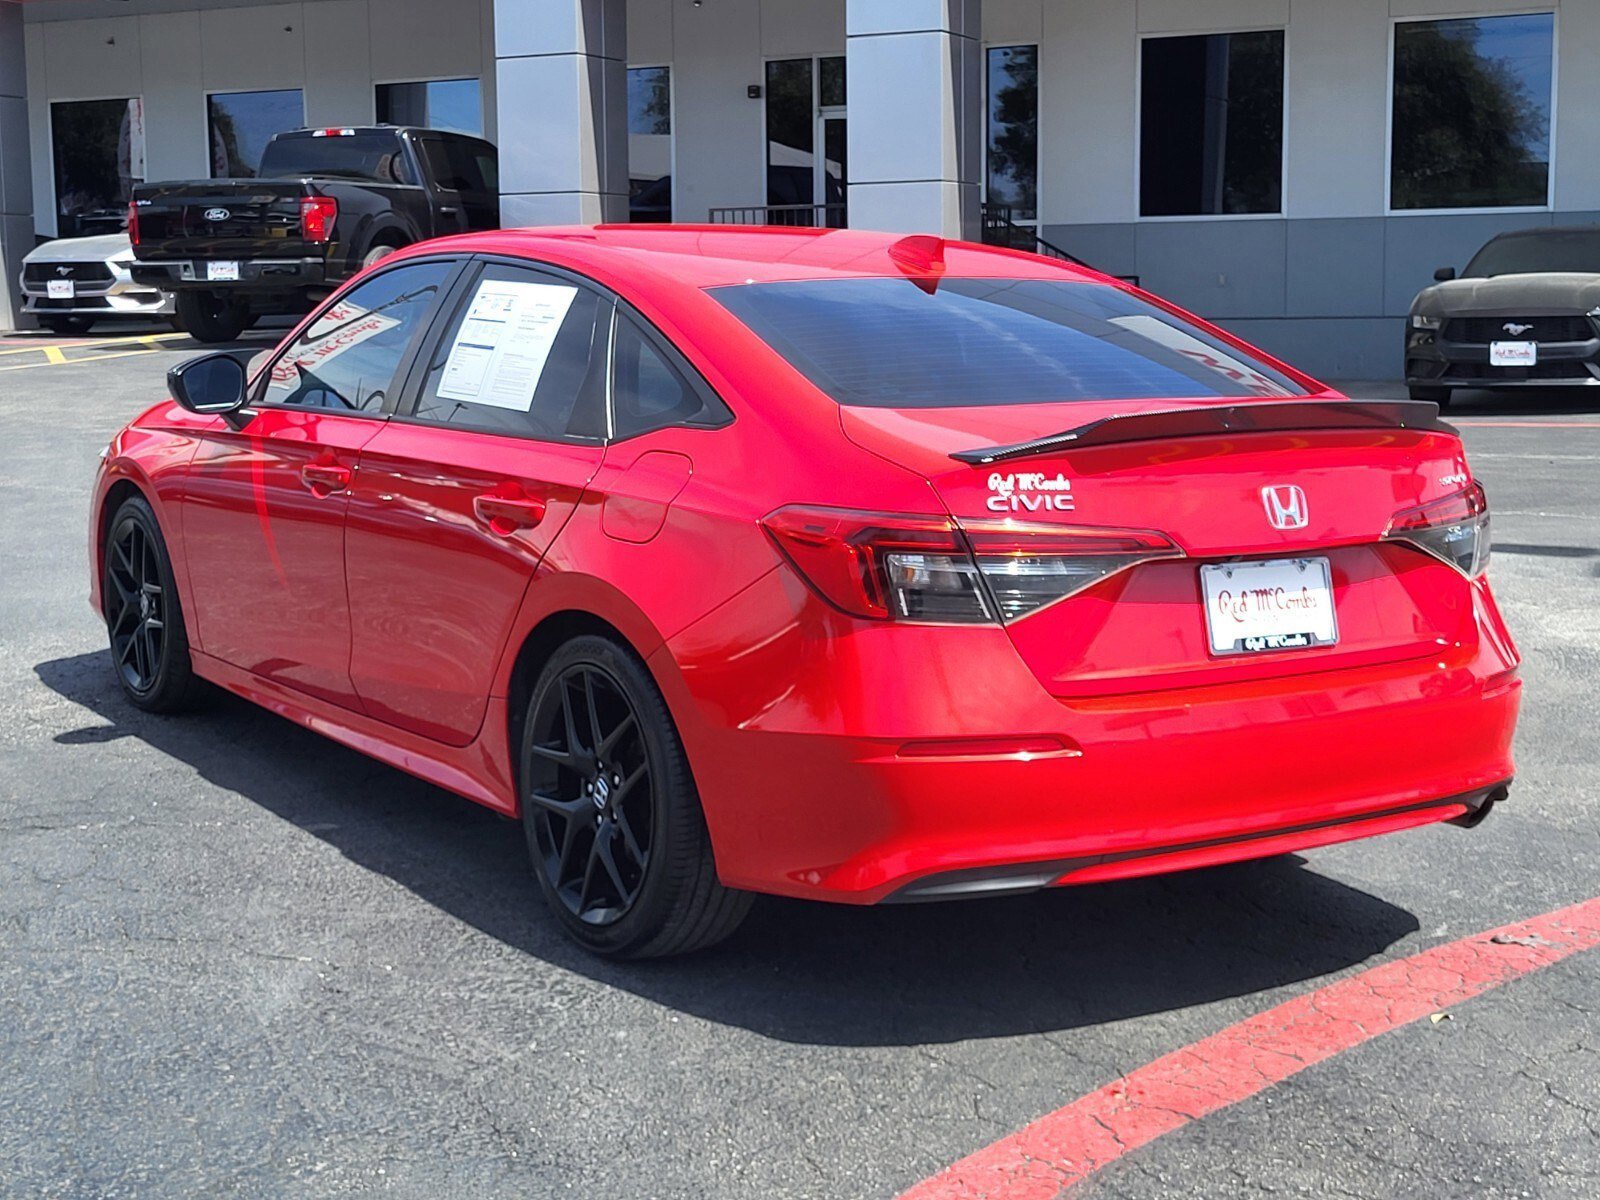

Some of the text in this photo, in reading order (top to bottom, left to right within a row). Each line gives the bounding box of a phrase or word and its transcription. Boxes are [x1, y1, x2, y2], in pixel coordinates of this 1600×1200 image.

[207, 209, 228, 219] Ford
[987, 472, 1070, 497] Red McCombs
[986, 494, 1075, 511] CIVIC
[1218, 586, 1317, 622] Red McCombs
